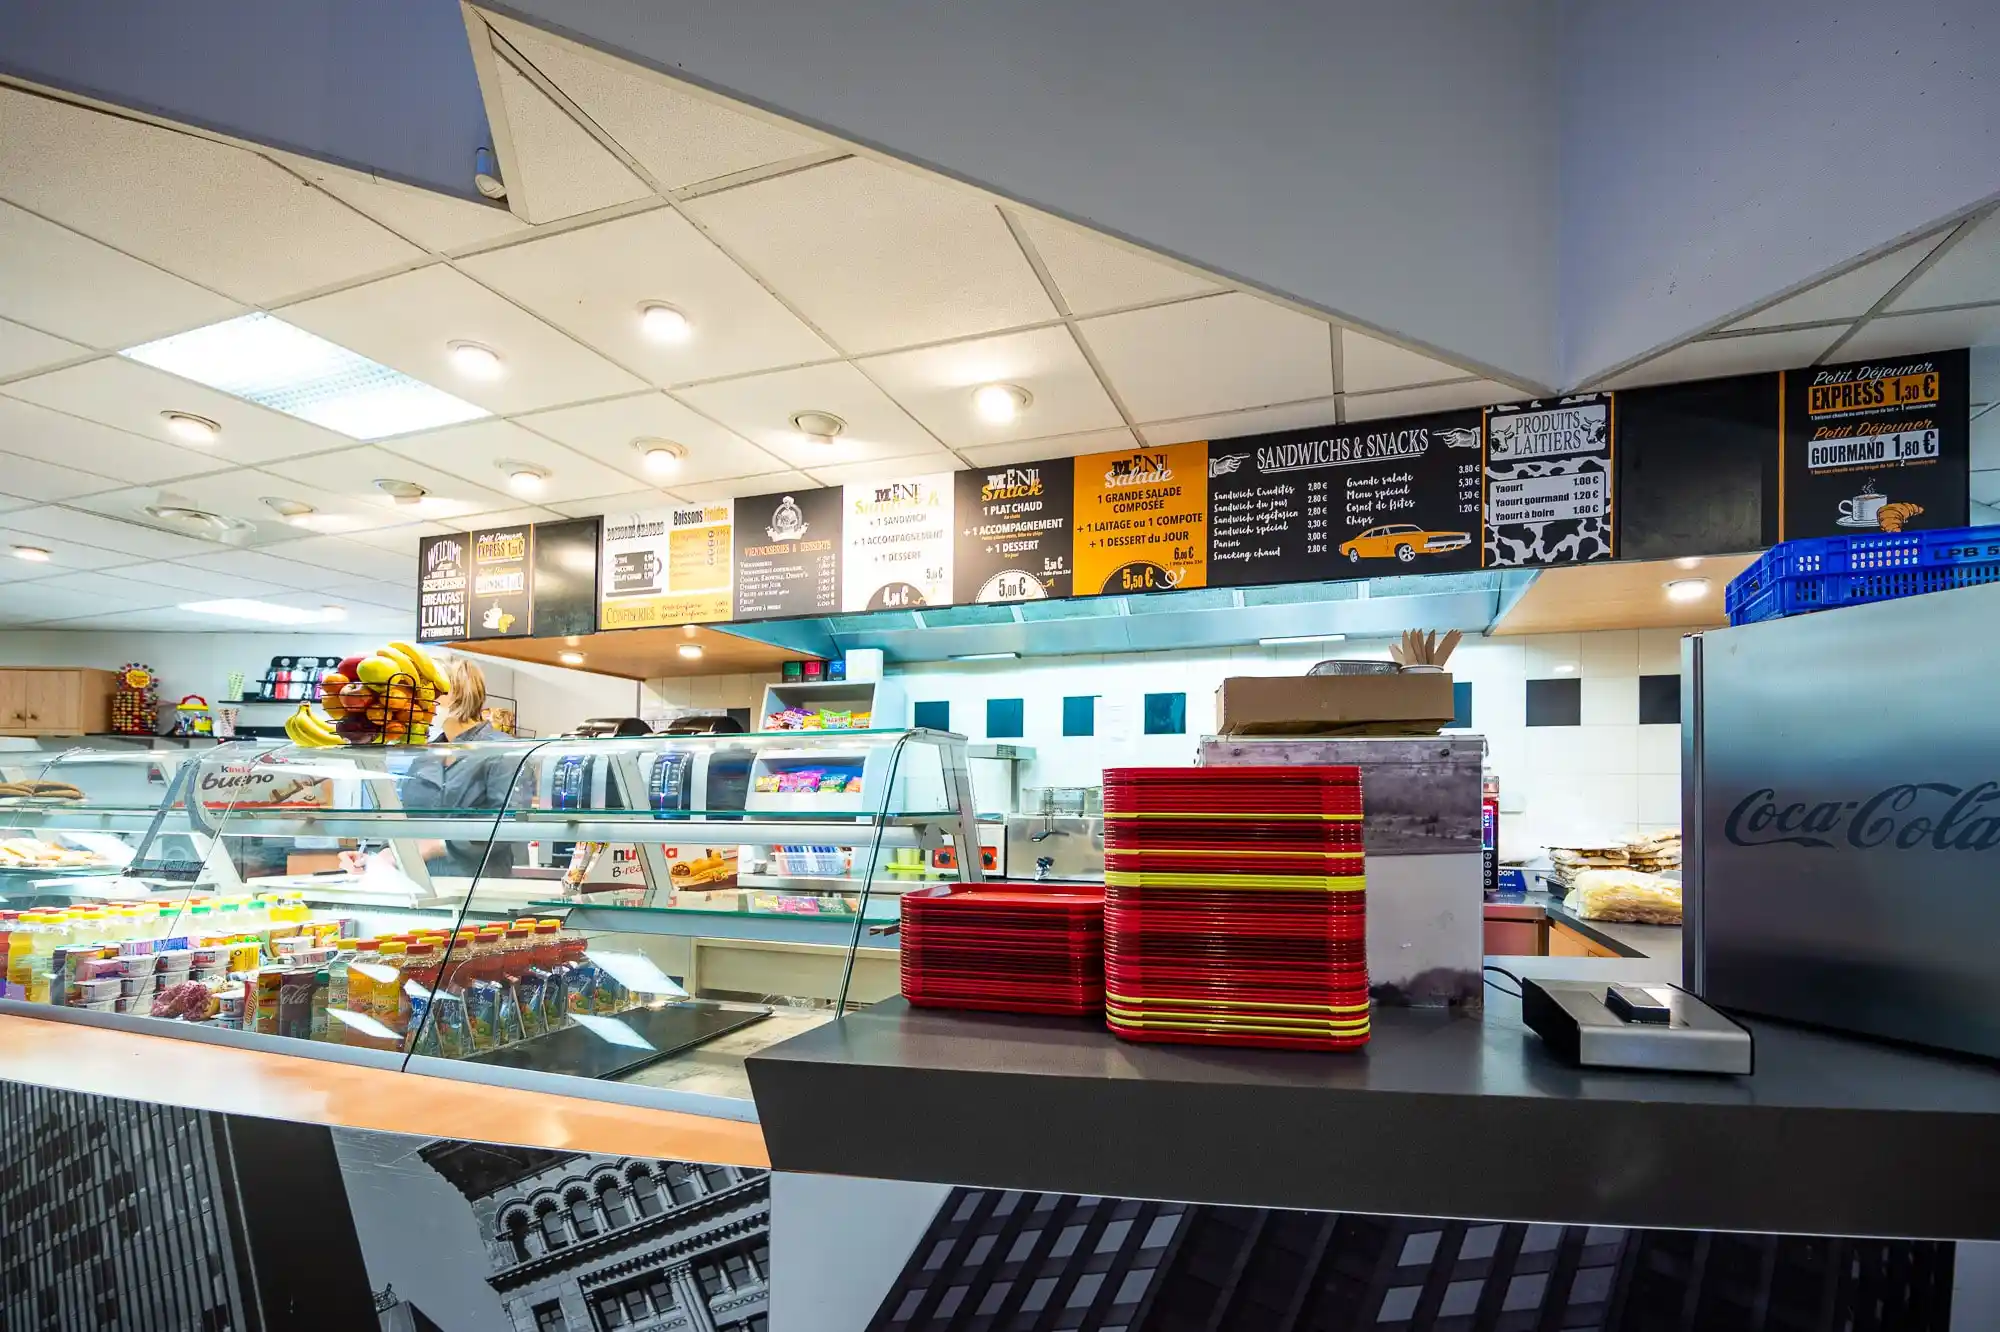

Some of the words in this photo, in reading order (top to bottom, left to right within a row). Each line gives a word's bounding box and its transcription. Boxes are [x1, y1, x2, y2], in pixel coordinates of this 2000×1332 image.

[1814, 369, 1853, 386] Petit
[1856, 361, 1934, 386] Déjeuner
[1812, 380, 1884, 410] EXPRESS
[1892, 378, 1920, 404] 1,30
[1923, 374, 1936, 398] €
[1515, 410, 1581, 435] PRODUITS
[1813, 426, 1852, 440] Petit
[1856, 418, 1934, 443] Déjeuner
[1256, 437, 1350, 470] SANDWICHS
[1353, 436, 1364, 458] &
[1366, 428, 1429, 458] SNACKS
[1514, 430, 1582, 456] LAITIERS
[1811, 440, 1884, 465] GOURMAND
[1892, 434, 1920, 459] 1,80
[1923, 430, 1936, 454] €
[987, 468, 1040, 490] MENU
[1104, 464, 1174, 488] Salade
[1346, 476, 1380, 488] Grande
[1382, 472, 1414, 485] salade
[1474, 464, 1480, 472] €
[1496, 483, 1524, 494] Yaourt
[1592, 475, 1600, 484] €
[981, 481, 1044, 502] Snack
[1098, 495, 1102, 504] 1
[1106, 490, 1144, 504] GRANDE
[1146, 486, 1182, 499] SALADE
[1214, 488, 1254, 500] Sandwich
[1256, 484, 1296, 496] Crudités
[1308, 482, 1321, 492] 2,80
[1322, 482, 1328, 490] €
[1346, 490, 1372, 500] Menu
[1375, 484, 1410, 500] spécial
[1458, 478, 1473, 488] 5,30
[1214, 500, 1254, 513] Sandwich
[1256, 500, 1268, 509] du
[1268, 498, 1288, 510] jour
[1346, 500, 1372, 512] Cornet
[1376, 500, 1387, 510] de
[1390, 498, 1416, 511] frites
[1459, 492, 1472, 500] 1,50
[1496, 498, 1524, 508] Yaourt
[1524, 492, 1570, 506] gourmand
[1573, 491, 1591, 500] 1.20
[1592, 490, 1600, 499] €
[983, 506, 988, 516] 1
[990, 504, 1012, 516] PLAT
[1012, 501, 1042, 513] CHAUD
[1214, 512, 1254, 525] Sandwich
[1256, 509, 1298, 524] végétarien
[1322, 506, 1328, 514] €
[1496, 511, 1524, 522] Yaourt
[1525, 508, 1530, 519] à
[1531, 508, 1554, 518] boire
[1573, 505, 1591, 515] 1.80
[1592, 504, 1600, 513] €
[674, 510, 702, 526] Boissons
[884, 514, 927, 526] SANDWICH
[963, 528, 970, 536] +
[972, 526, 978, 536] 1
[980, 518, 1064, 536] ACCOMPAGNEMENT
[1087, 524, 1092, 532] 1
[1094, 520, 1131, 532] LAITAGE
[1148, 518, 1153, 526] 1
[1156, 513, 1203, 526] COMPOTE
[1346, 515, 1374, 526] Chips
[1214, 524, 1254, 536] Sandwich
[1256, 521, 1288, 536] spécial
[1308, 520, 1321, 529] 3,30
[800, 540, 831, 552] DESSERTS
[868, 530, 944, 545] ACCOMPAGNEMENT
[1100, 538, 1104, 548] 1
[1108, 534, 1146, 547] DESSERT
[1148, 534, 1160, 544] du
[1162, 531, 1190, 542] JOUR
[1214, 540, 1240, 548] Panini
[1308, 532, 1321, 542] 3,00
[1322, 532, 1328, 540] €
[428, 540, 462, 572] WELCOME
[478, 542, 505, 558] EXPRESS
[986, 546, 993, 554] +
[995, 544, 1000, 553] 1
[1003, 540, 1040, 552] DESSERT
[1214, 552, 1252, 562] Snacking
[1254, 546, 1280, 558] chaud
[888, 551, 922, 562] DESSERT
[998, 578, 1017, 598] 5,00
[1122, 568, 1142, 590] 5,50
[422, 592, 464, 606] BREAKFAST
[422, 604, 464, 627] LUNCH
[454, 626, 464, 636] TEA
[202, 772, 274, 790] bueno
[1724, 782, 2000, 852] Coca-Cola
